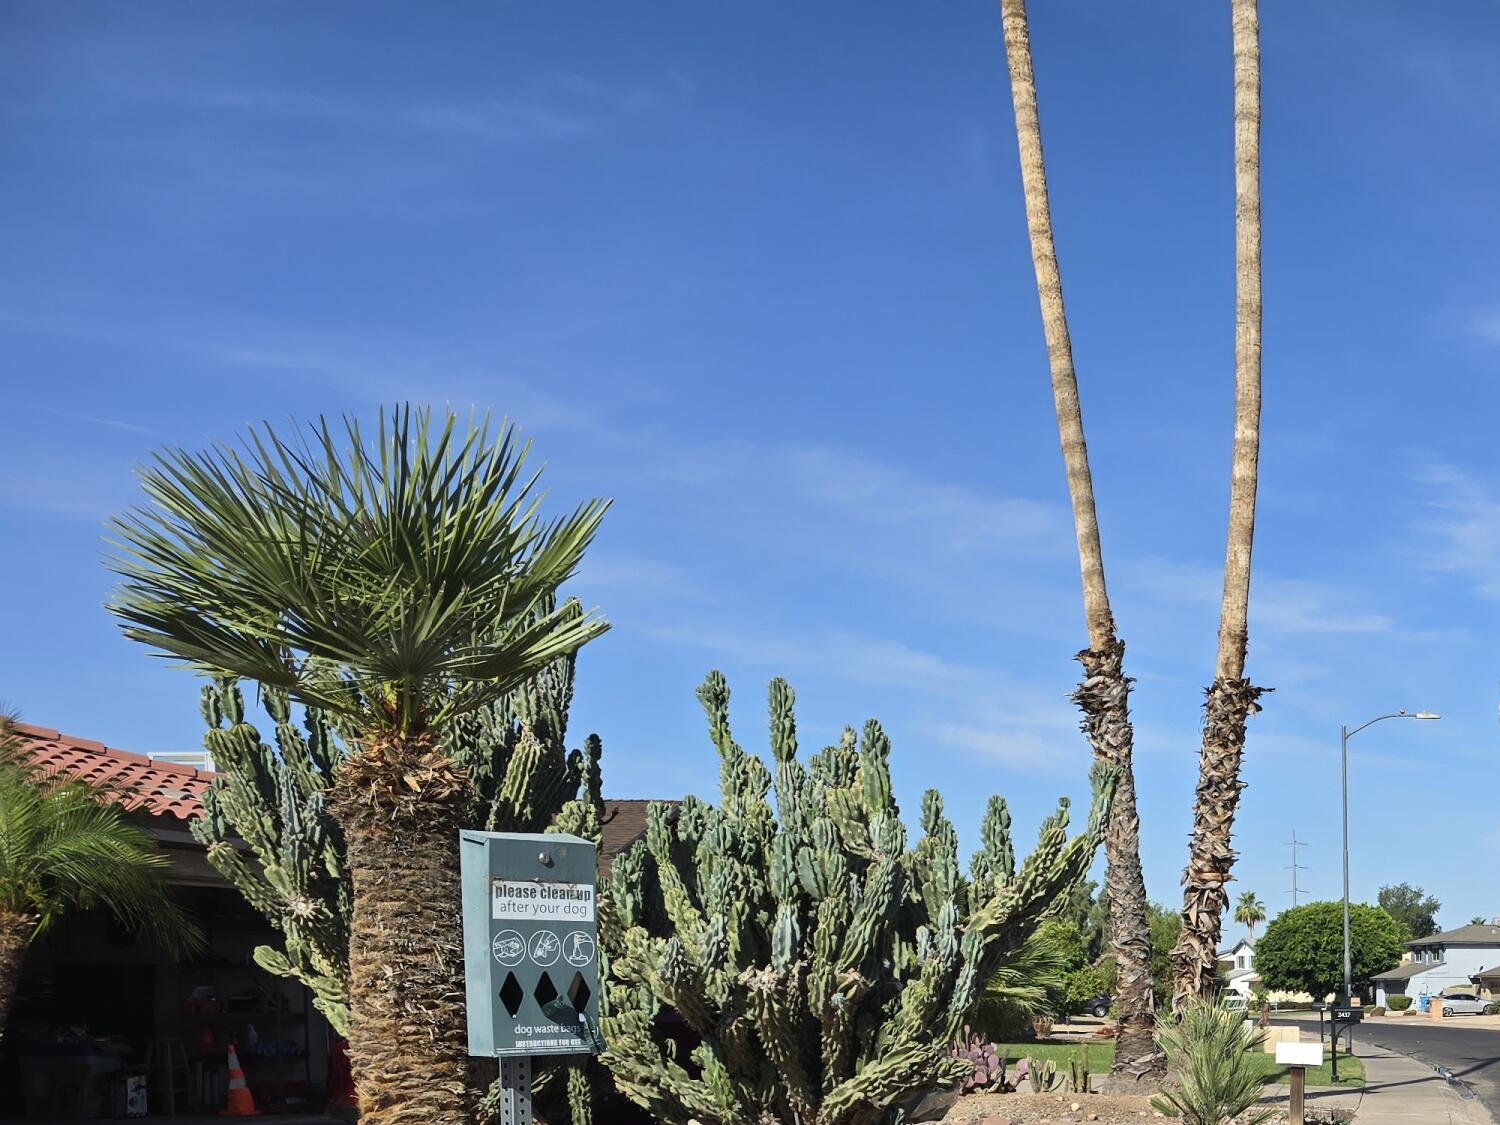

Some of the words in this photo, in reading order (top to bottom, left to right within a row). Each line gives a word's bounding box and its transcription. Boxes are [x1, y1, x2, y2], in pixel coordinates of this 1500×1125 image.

[495, 884, 537, 899] please
[577, 889, 591, 902] up
[500, 900, 529, 912] after
[532, 902, 560, 916] your
[563, 902, 587, 917] dog
[514, 1024, 532, 1036] dog
[533, 1025, 559, 1034] waste
